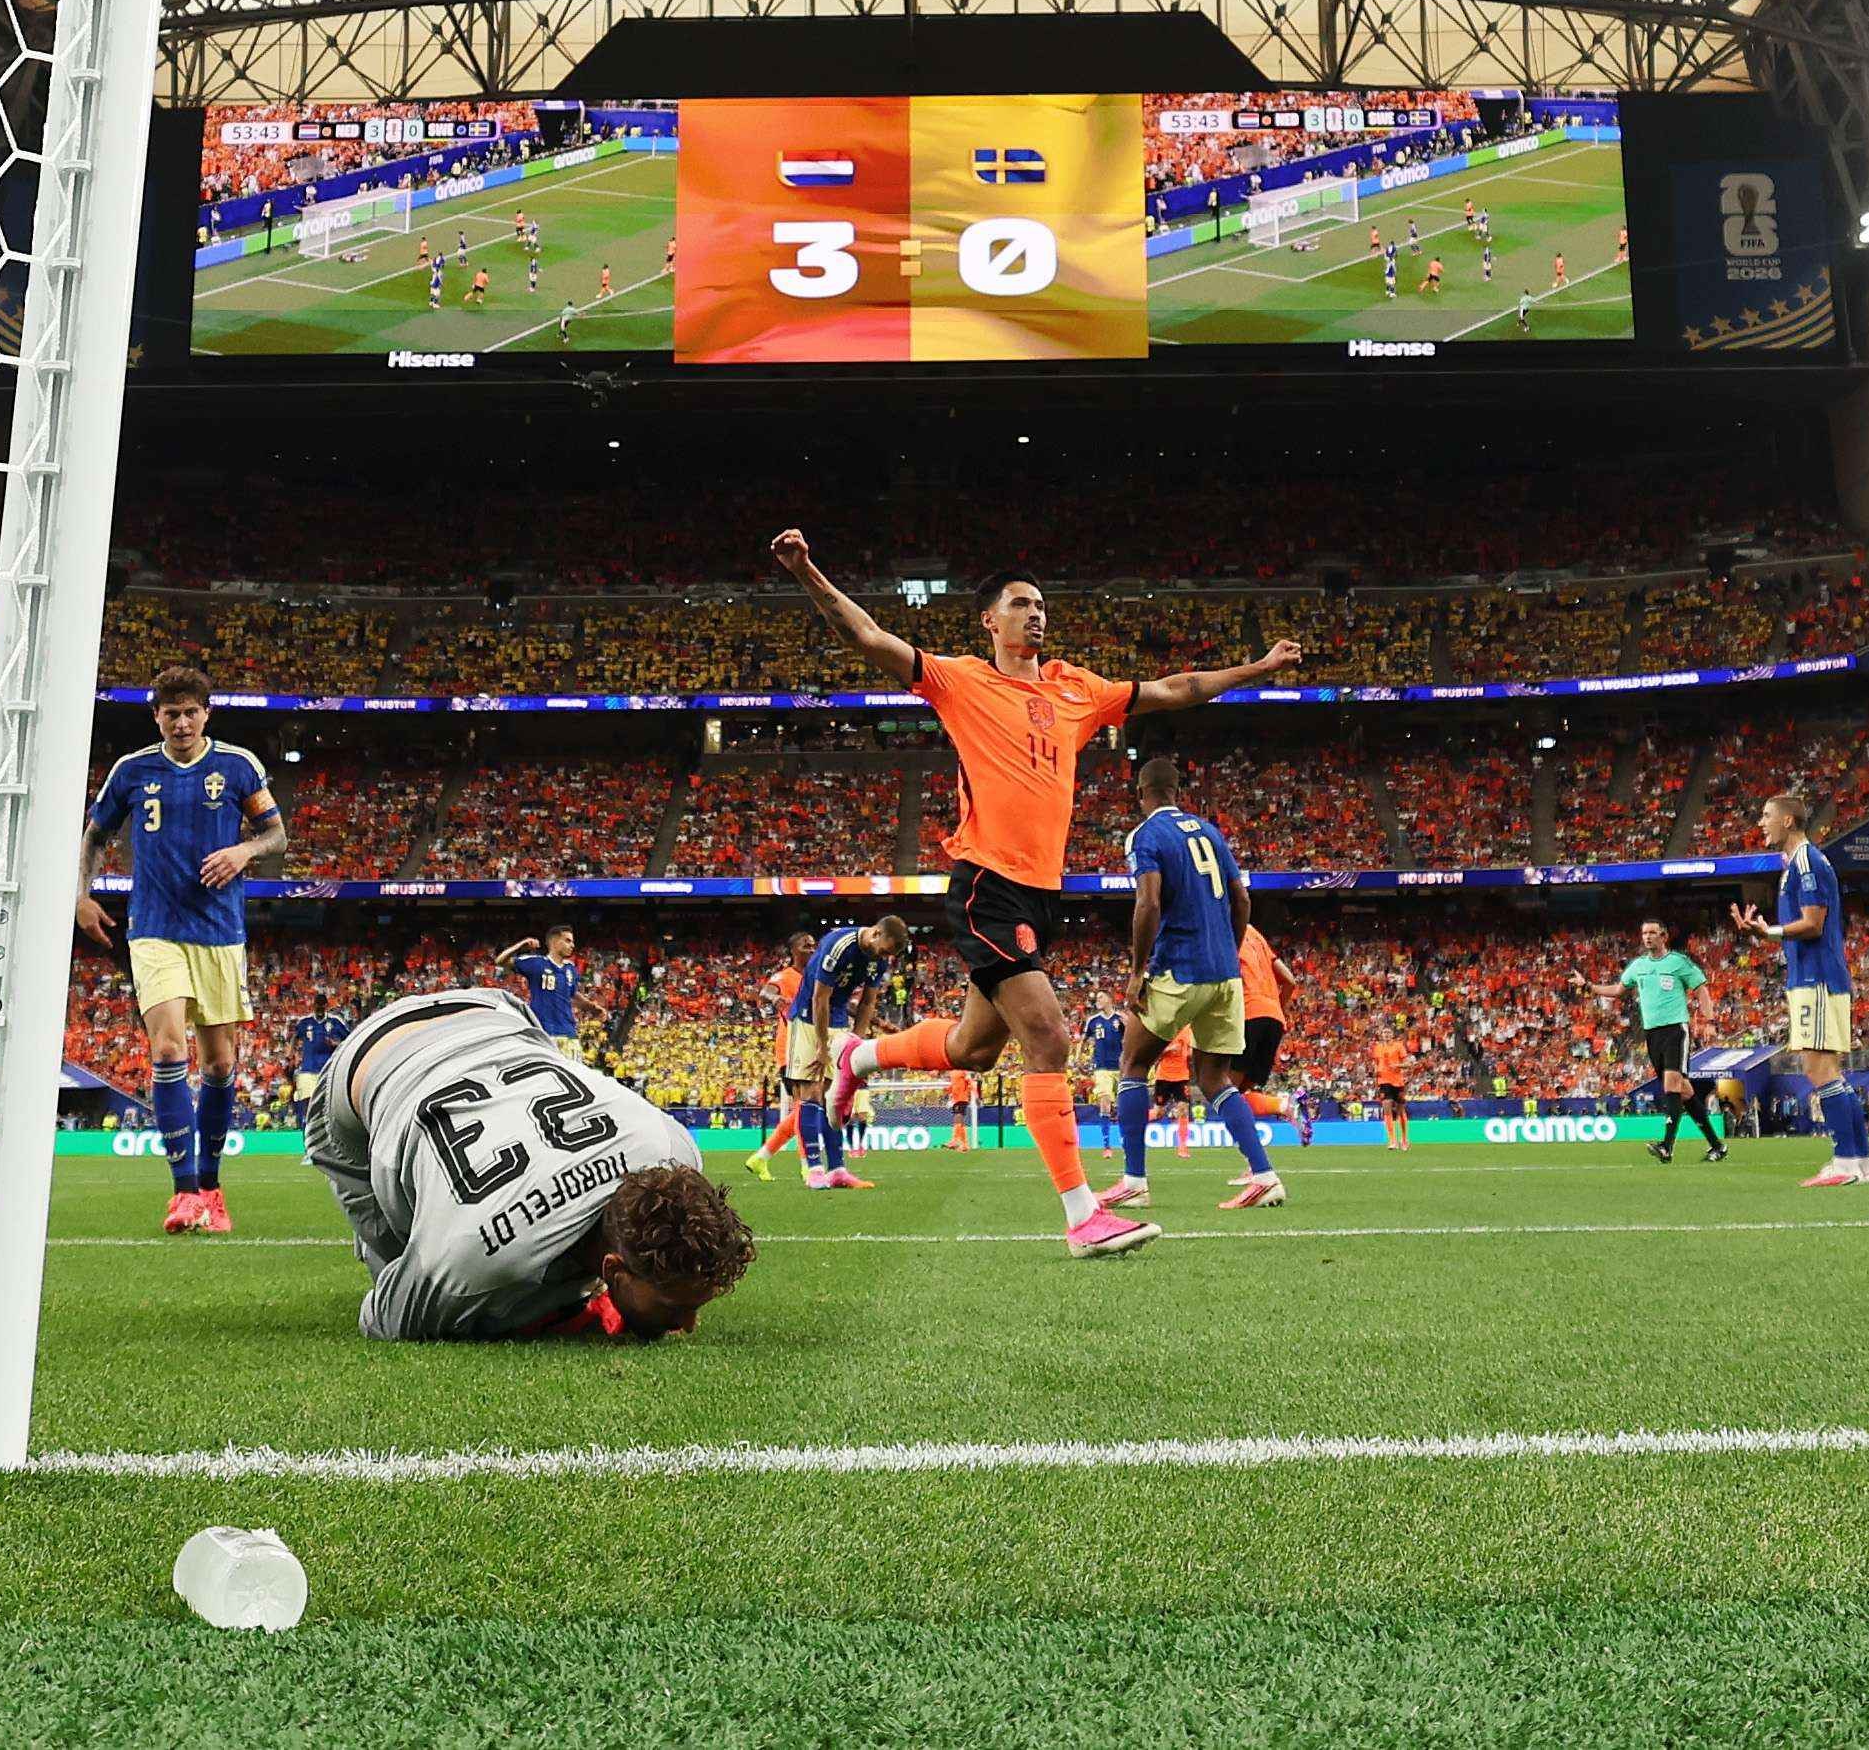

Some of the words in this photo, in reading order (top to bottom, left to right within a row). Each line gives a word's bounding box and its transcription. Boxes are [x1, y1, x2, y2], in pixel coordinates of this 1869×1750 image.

[1171, 113, 1220, 129] 53:43
[1310, 113, 1320, 127] 3
[1349, 113, 1359, 126] 0
[232, 124, 280, 140] 53:43
[369, 124, 379, 138] 3
[408, 124, 418, 138] 0
[1380, 162, 1430, 190] aramco
[435, 174, 484, 201] aramco
[768, 221, 860, 298] 3
[958, 217, 1059, 296] 0
[1726, 258, 1760, 266] WORLD
[1762, 258, 1782, 266] CUP
[1348, 339, 1436, 357] Hisense
[388, 350, 475, 368] Hisense
[1796, 657, 1849, 673] HOUSTON
[1433, 686, 1484, 698] HOUSTON
[1603, 677, 1641, 691] WORLD
[1641, 676, 1662, 688] CUP
[364, 699, 417, 710] HOUSTON
[719, 696, 772, 707] HOUSTON
[1027, 732, 1058, 775] 14
[144, 799, 162, 833] 3
[1188, 836, 1224, 900] 4
[1101, 876, 1130, 889] FIFA
[1397, 872, 1464, 886] HOUSTON
[380, 883, 446, 896] HOUSTON
[541, 973, 556, 991] 18
[1800, 1004, 1811, 1026] 2
[414, 1060, 619, 1205] 23
[1144, 1121, 1273, 1148] aramo
[1484, 1116, 1618, 1143] aramco
[113, 1130, 245, 1157] arao
